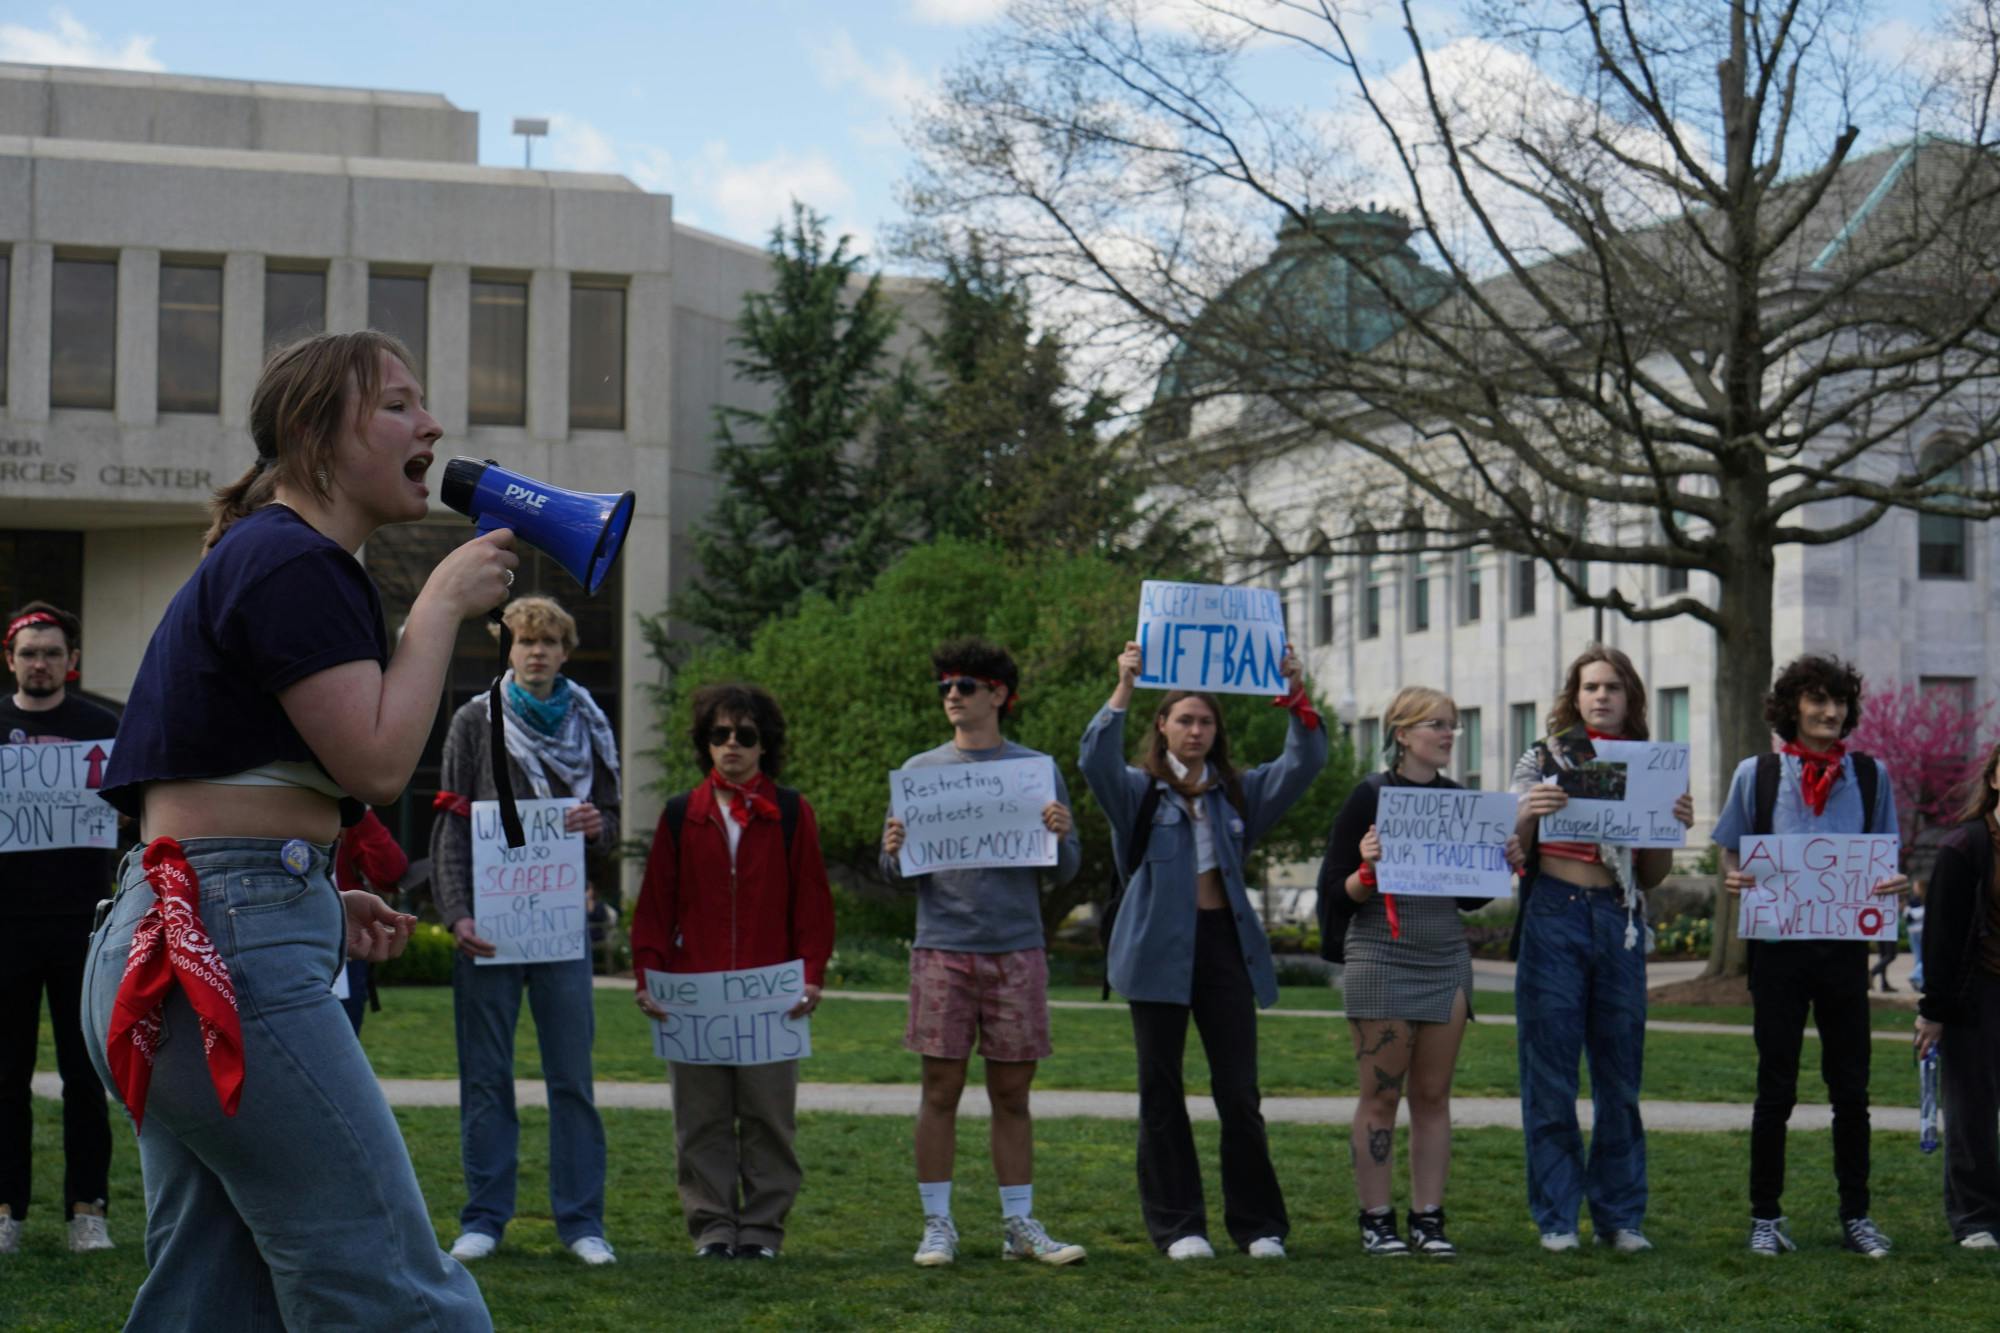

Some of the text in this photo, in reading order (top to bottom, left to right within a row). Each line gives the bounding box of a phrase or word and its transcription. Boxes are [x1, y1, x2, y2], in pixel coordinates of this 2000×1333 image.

[99, 464, 212, 489] CENTER
[505, 483, 550, 508] PYLE
[1144, 585, 1200, 617] ACCEPT
[1140, 623, 1286, 690] LIFT BAN
[1647, 747, 1687, 771] 2017
[904, 802, 983, 828] Protests
[1379, 818, 1507, 846] ADVOCACY IS
[497, 845, 551, 864] YOU SO
[480, 863, 577, 891] SCARED
[512, 893, 541, 913] OF
[480, 904, 580, 940] STUDENT
[1745, 905, 1769, 936] IF
[723, 968, 800, 1001] have
[659, 1010, 802, 1063] RIGHTS
